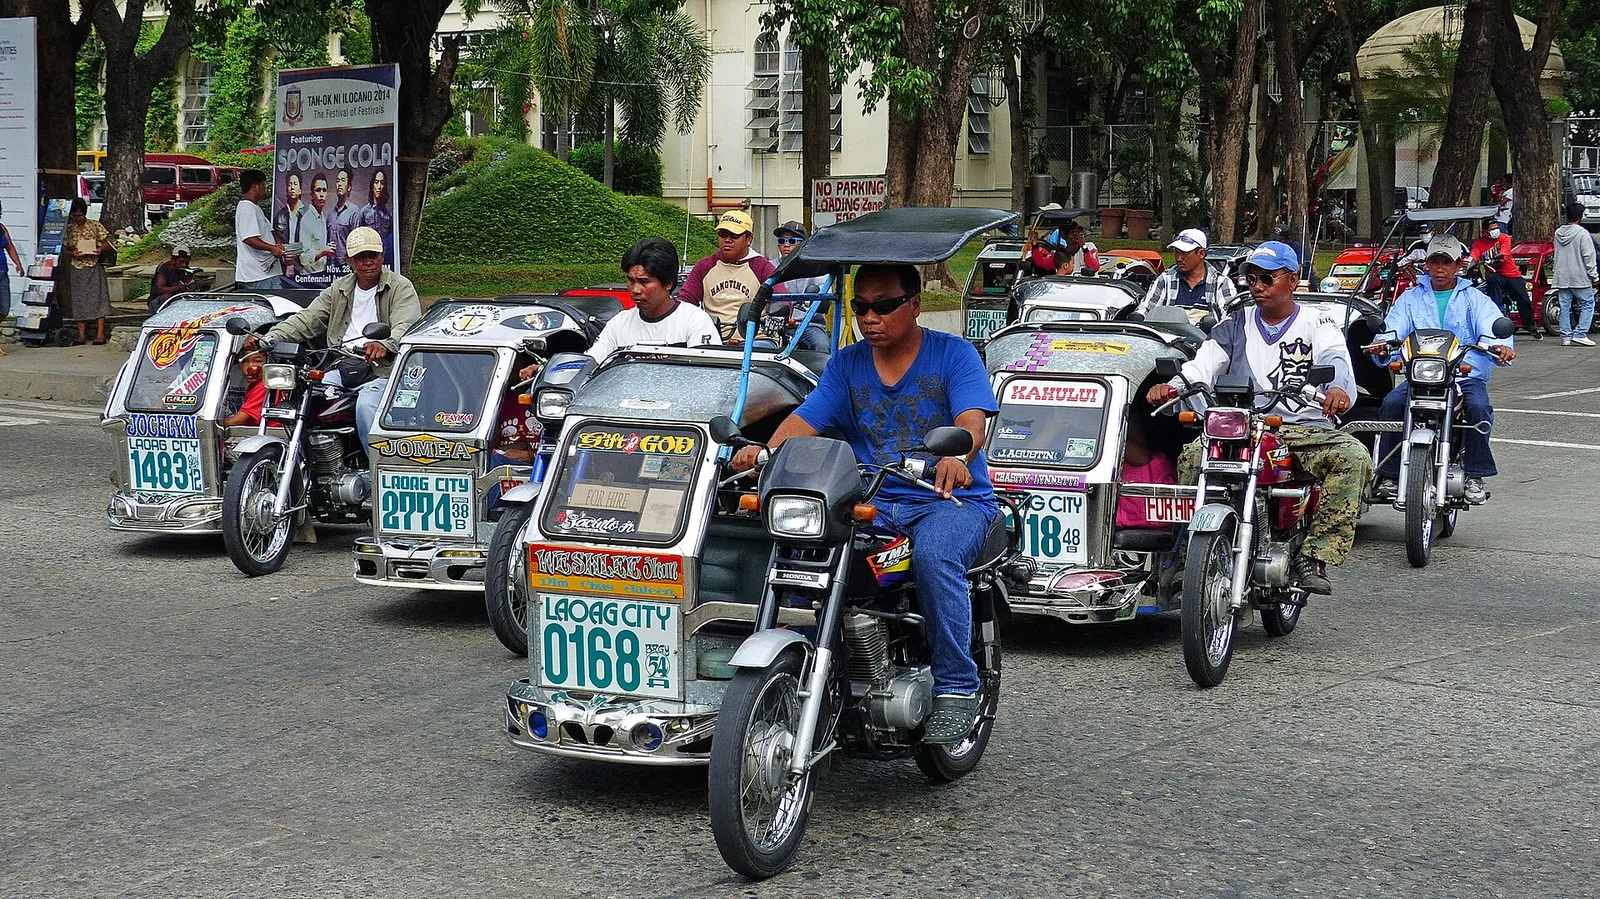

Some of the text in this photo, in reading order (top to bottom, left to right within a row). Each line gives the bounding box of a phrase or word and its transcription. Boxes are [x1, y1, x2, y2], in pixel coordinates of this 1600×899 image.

[307, 89, 391, 106] TAN-OK NI ILOCANO 2014
[313, 105, 385, 119] The Festival of Festivals
[290, 134, 323, 144] Featuring:
[277, 142, 391, 172] SPONGE COLA
[816, 180, 884, 197] NO PARKING
[815, 197, 883, 213] LOADING Zone
[326, 264, 341, 273] Nov.
[295, 274, 331, 283] Centennial
[968, 311, 1007, 319] LAOAG CITY
[1010, 385, 1099, 403] KAHULUI
[127, 414, 197, 438] JOCELYN
[129, 439, 198, 452] LAOAG CITY
[640, 434, 695, 454] GOD
[130, 450, 189, 490] 1483
[189, 469, 202, 490] 12
[381, 475, 469, 492] LAOAG CITY
[585, 489, 605, 506] FOR
[606, 491, 630, 509] HIRE
[1048, 495, 1083, 514] CITY
[382, 490, 453, 532] 2774
[452, 503, 469, 519] 38
[1147, 497, 1196, 521] FOR HIR
[455, 519, 467, 530] B
[1062, 528, 1081, 546] 48
[876, 542, 910, 564] TMX
[882, 558, 900, 568] 155
[782, 572, 813, 581] HONDA
[545, 597, 671, 631] LAOAG CITY
[543, 622, 641, 692] 0168
[645, 643, 670, 657] BRGY
[648, 655, 668, 678] 54
